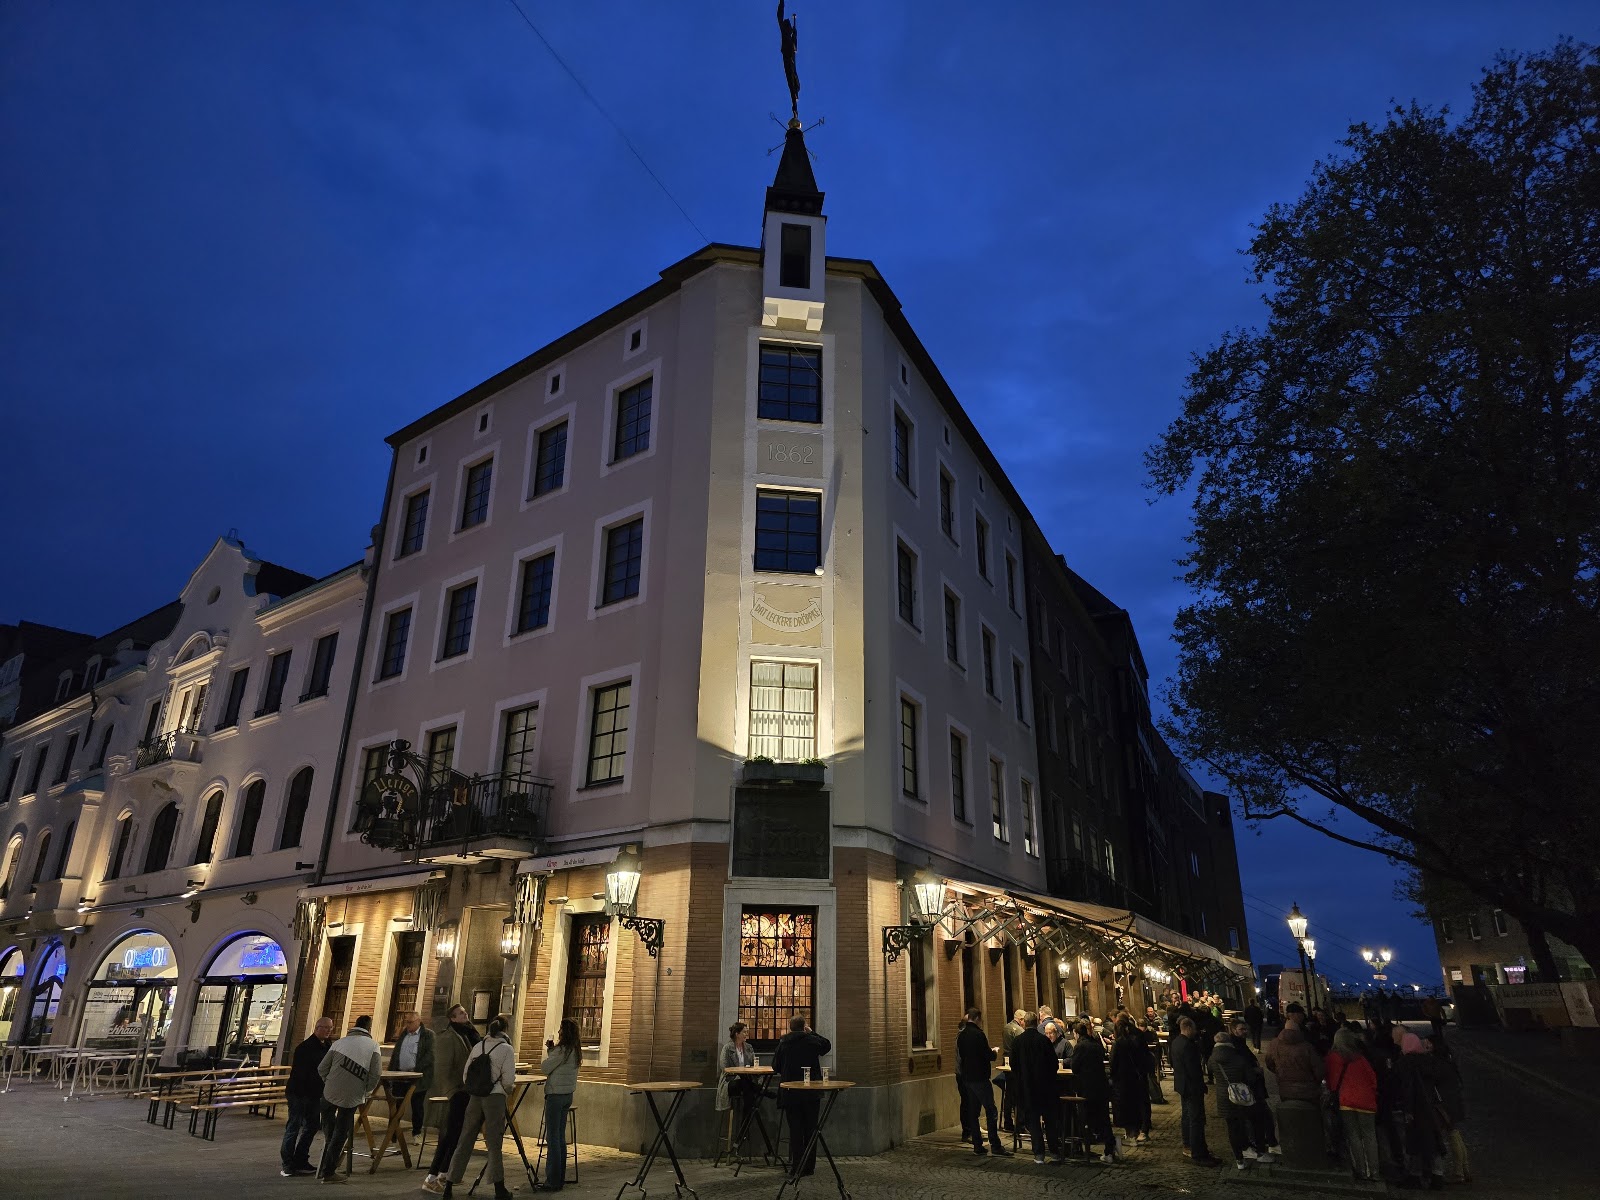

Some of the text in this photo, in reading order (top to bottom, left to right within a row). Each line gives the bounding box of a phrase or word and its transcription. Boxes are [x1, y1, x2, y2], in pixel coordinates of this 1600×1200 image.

[769, 442, 814, 464] 1862
[754, 603, 769, 617] DAT
[765, 611, 793, 627] LECKERE
[373, 777, 415, 797] Uerige
